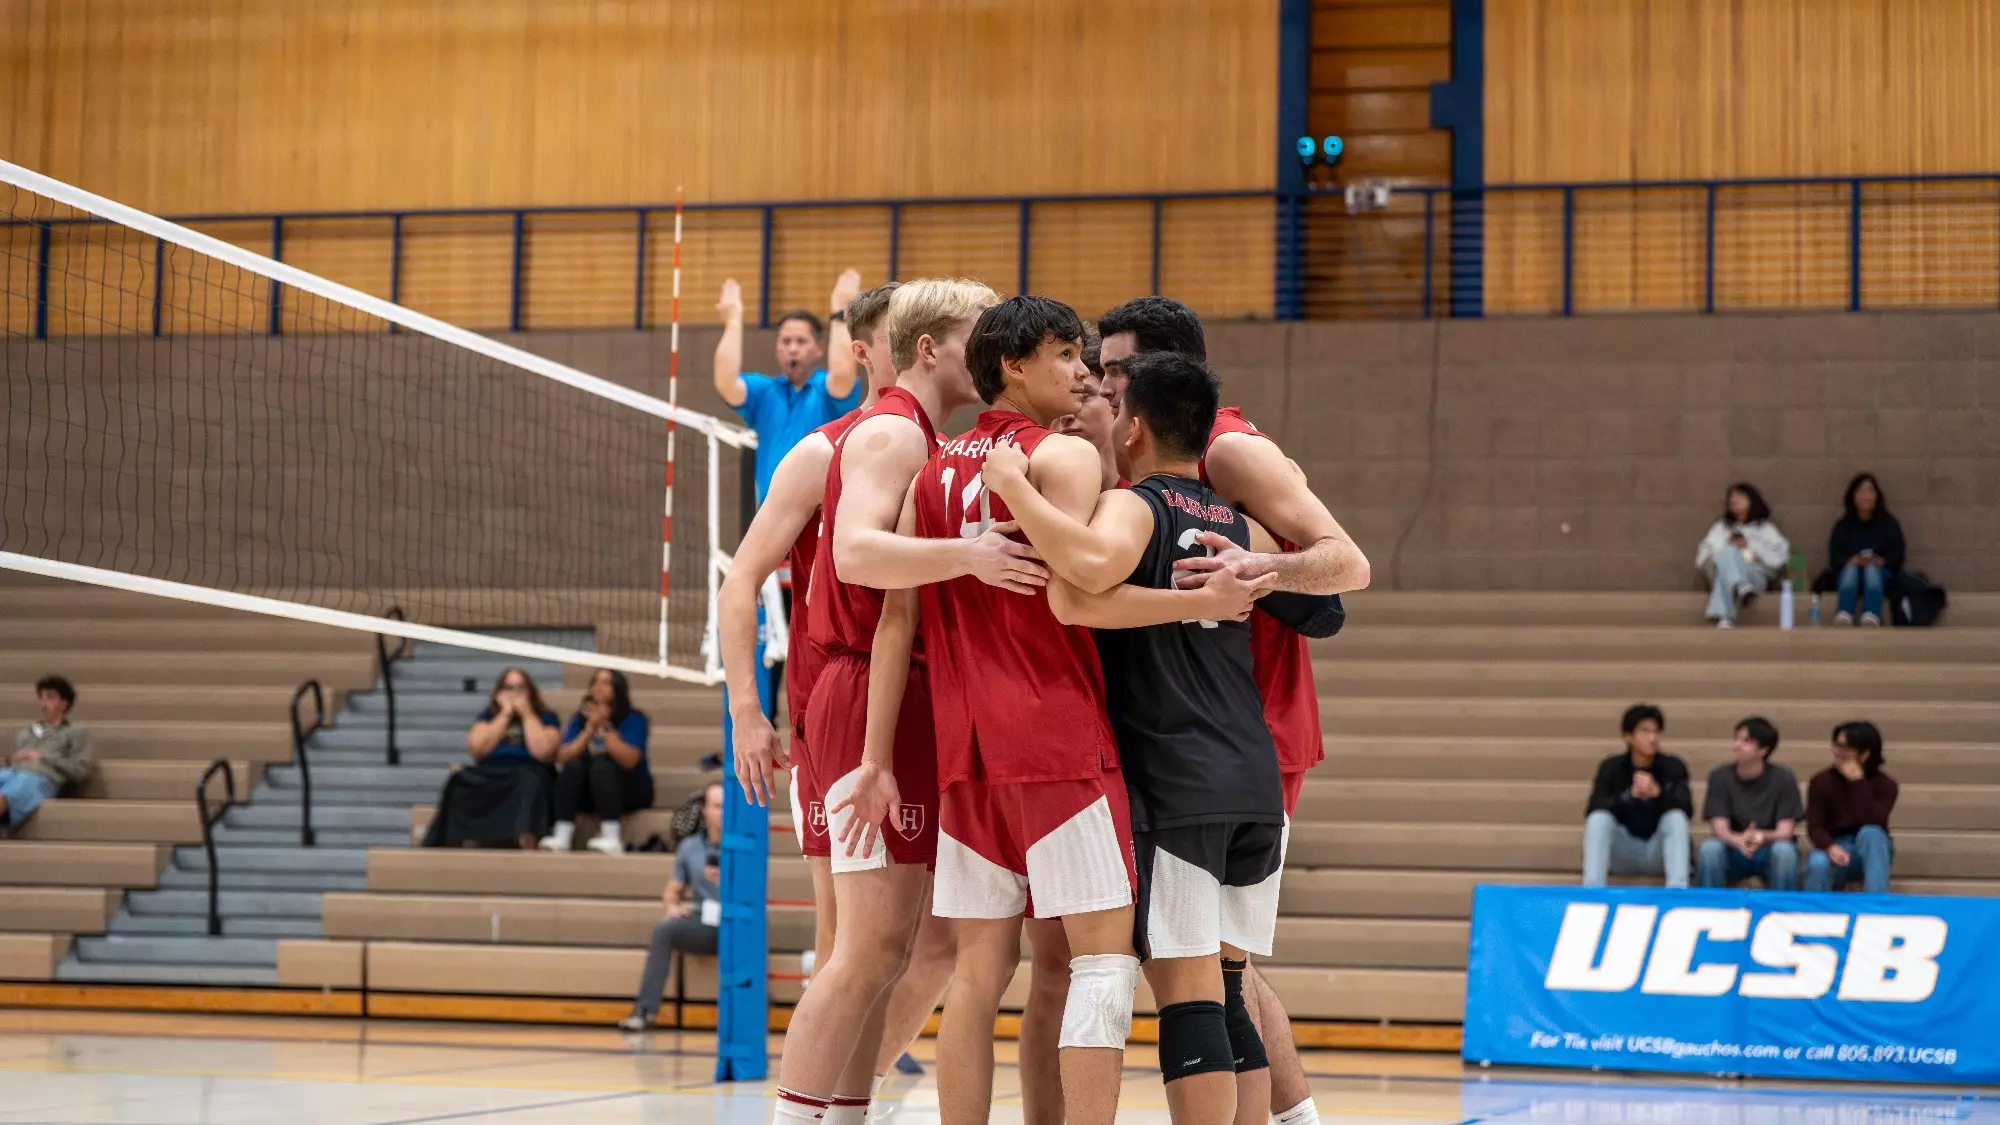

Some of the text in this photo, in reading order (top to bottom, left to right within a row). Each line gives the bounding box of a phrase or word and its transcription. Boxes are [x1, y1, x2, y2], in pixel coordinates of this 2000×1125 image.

[902, 808, 918, 830] H
[1544, 902, 1948, 1002] UCSB
[1529, 1030, 1560, 1049] For
[1591, 1033, 1625, 1052] visit
[1783, 1046, 1802, 1060] or
[1805, 1043, 1835, 1061] call
